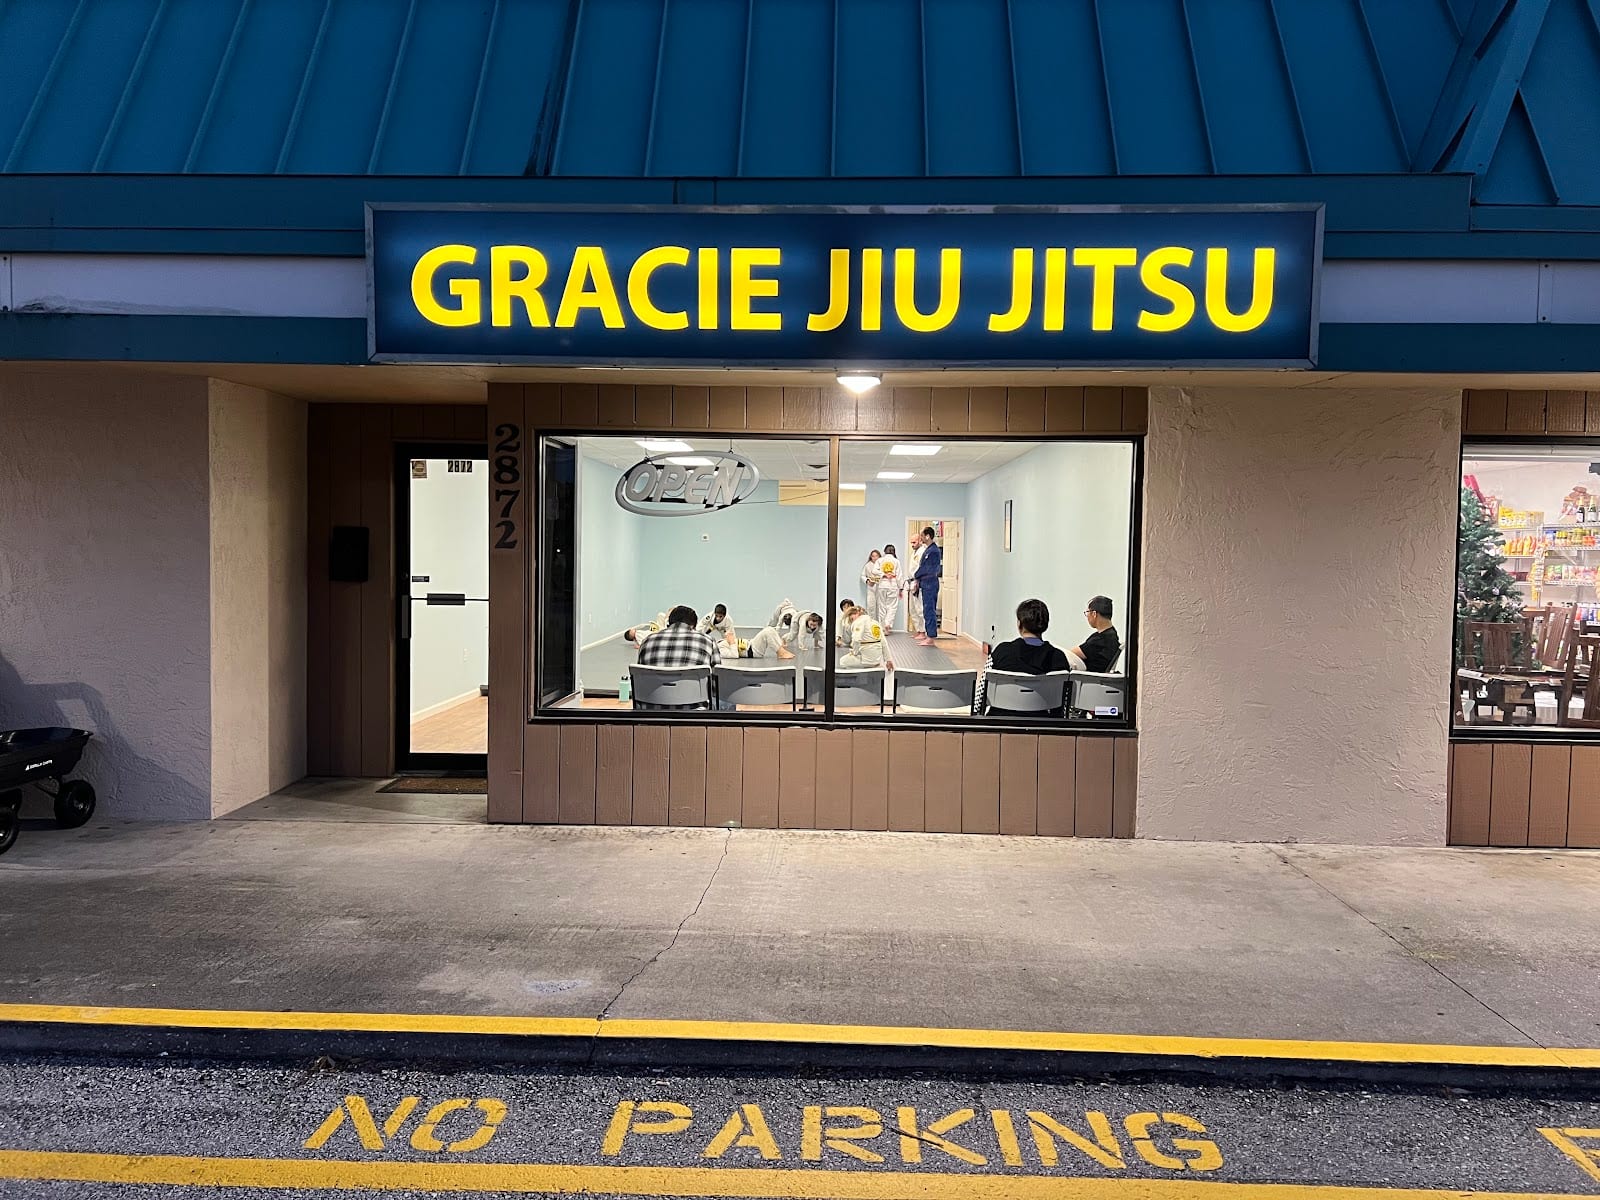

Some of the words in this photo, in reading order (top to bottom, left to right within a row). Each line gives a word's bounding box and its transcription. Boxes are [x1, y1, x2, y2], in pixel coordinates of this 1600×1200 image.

[411, 244, 782, 331] GRACIE
[807, 248, 962, 333] JIU
[988, 246, 1277, 333] JITSU
[448, 460, 473, 473] 2872
[494, 423, 520, 549] 2872
[625, 462, 745, 505] OPEN
[304, 1094, 507, 1153] NO
[602, 1102, 1224, 1172] PARKING
